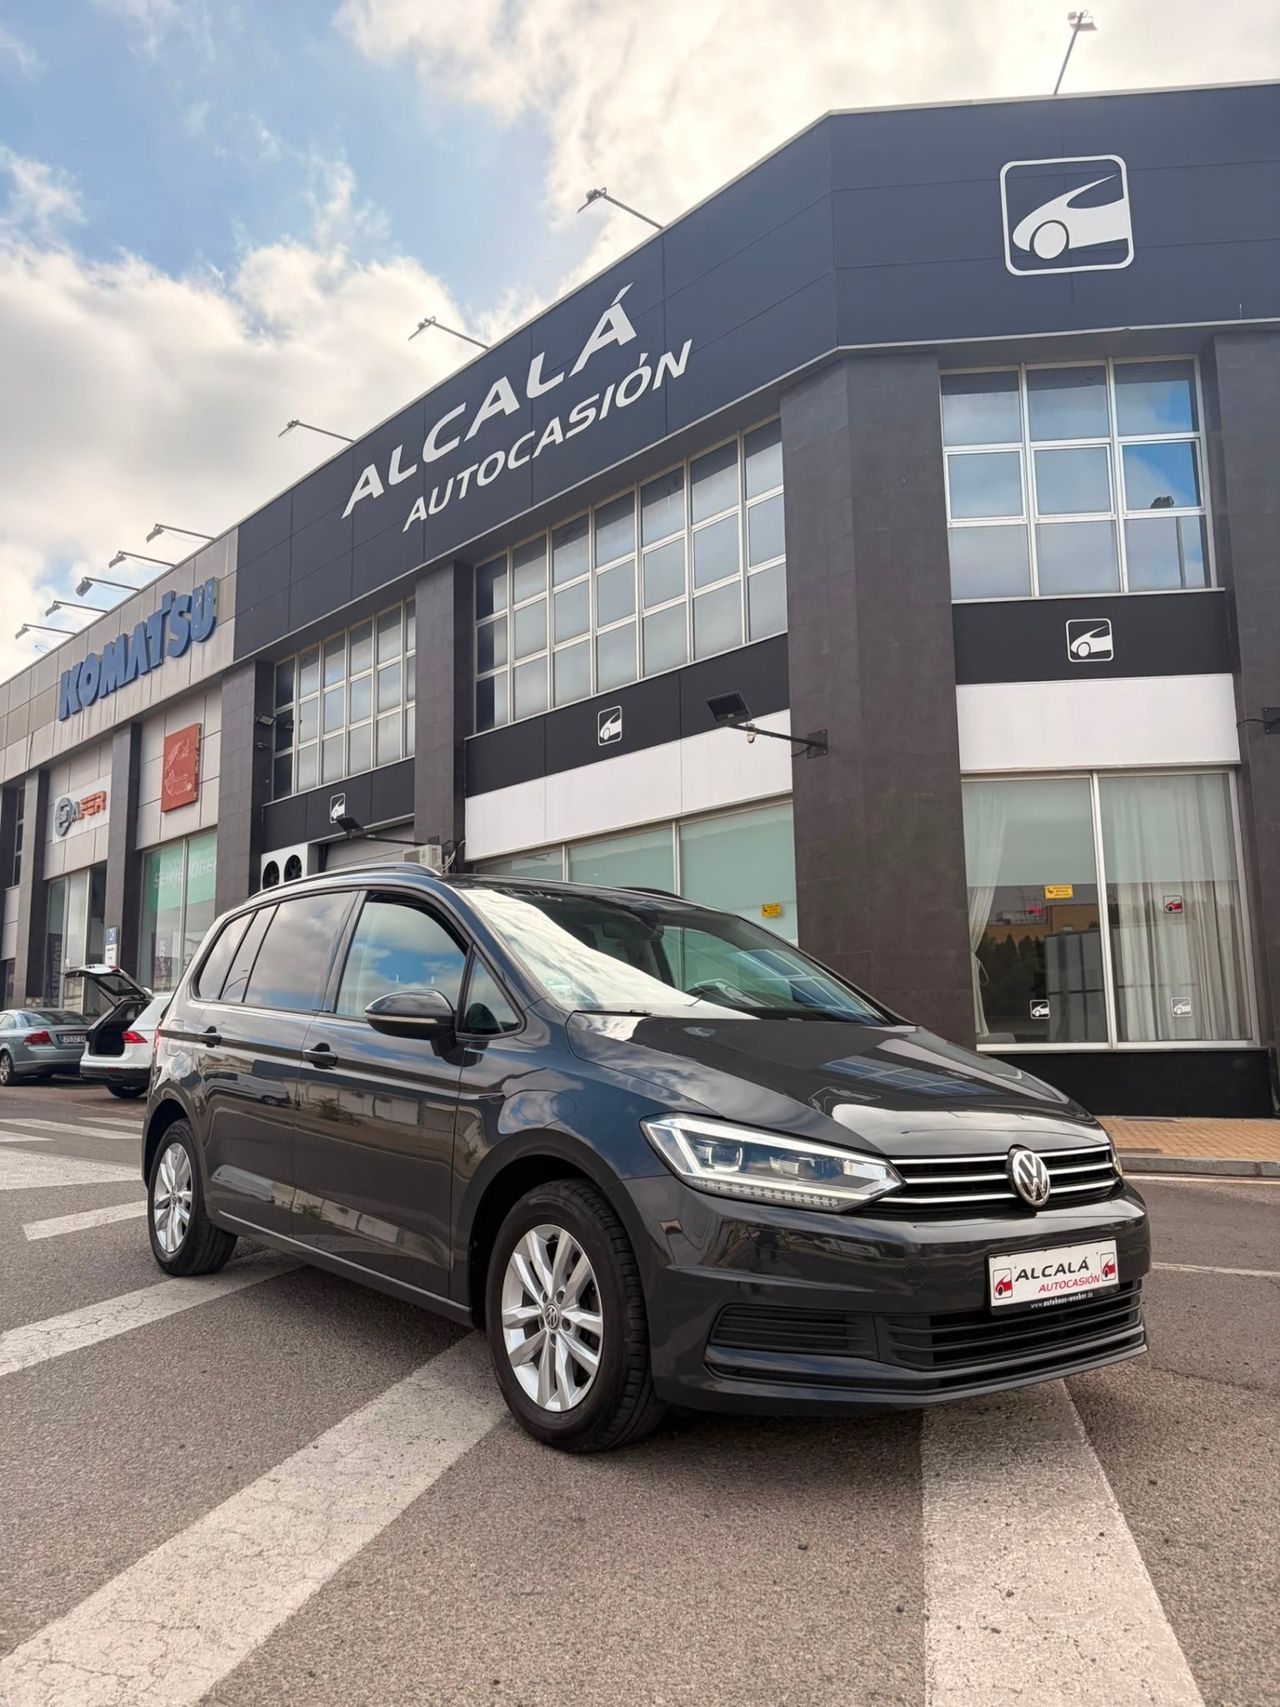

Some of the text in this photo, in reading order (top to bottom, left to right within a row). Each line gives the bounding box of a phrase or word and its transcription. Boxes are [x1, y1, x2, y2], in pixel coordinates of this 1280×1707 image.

[341, 282, 637, 519] ALCALÁ
[402, 339, 692, 532] AUTOCASIÓN
[59, 576, 219, 721] KOMATSU
[1015, 1256, 1089, 1282] ALCALÁ
[1038, 1273, 1100, 1293] AUTOCASIÓN
